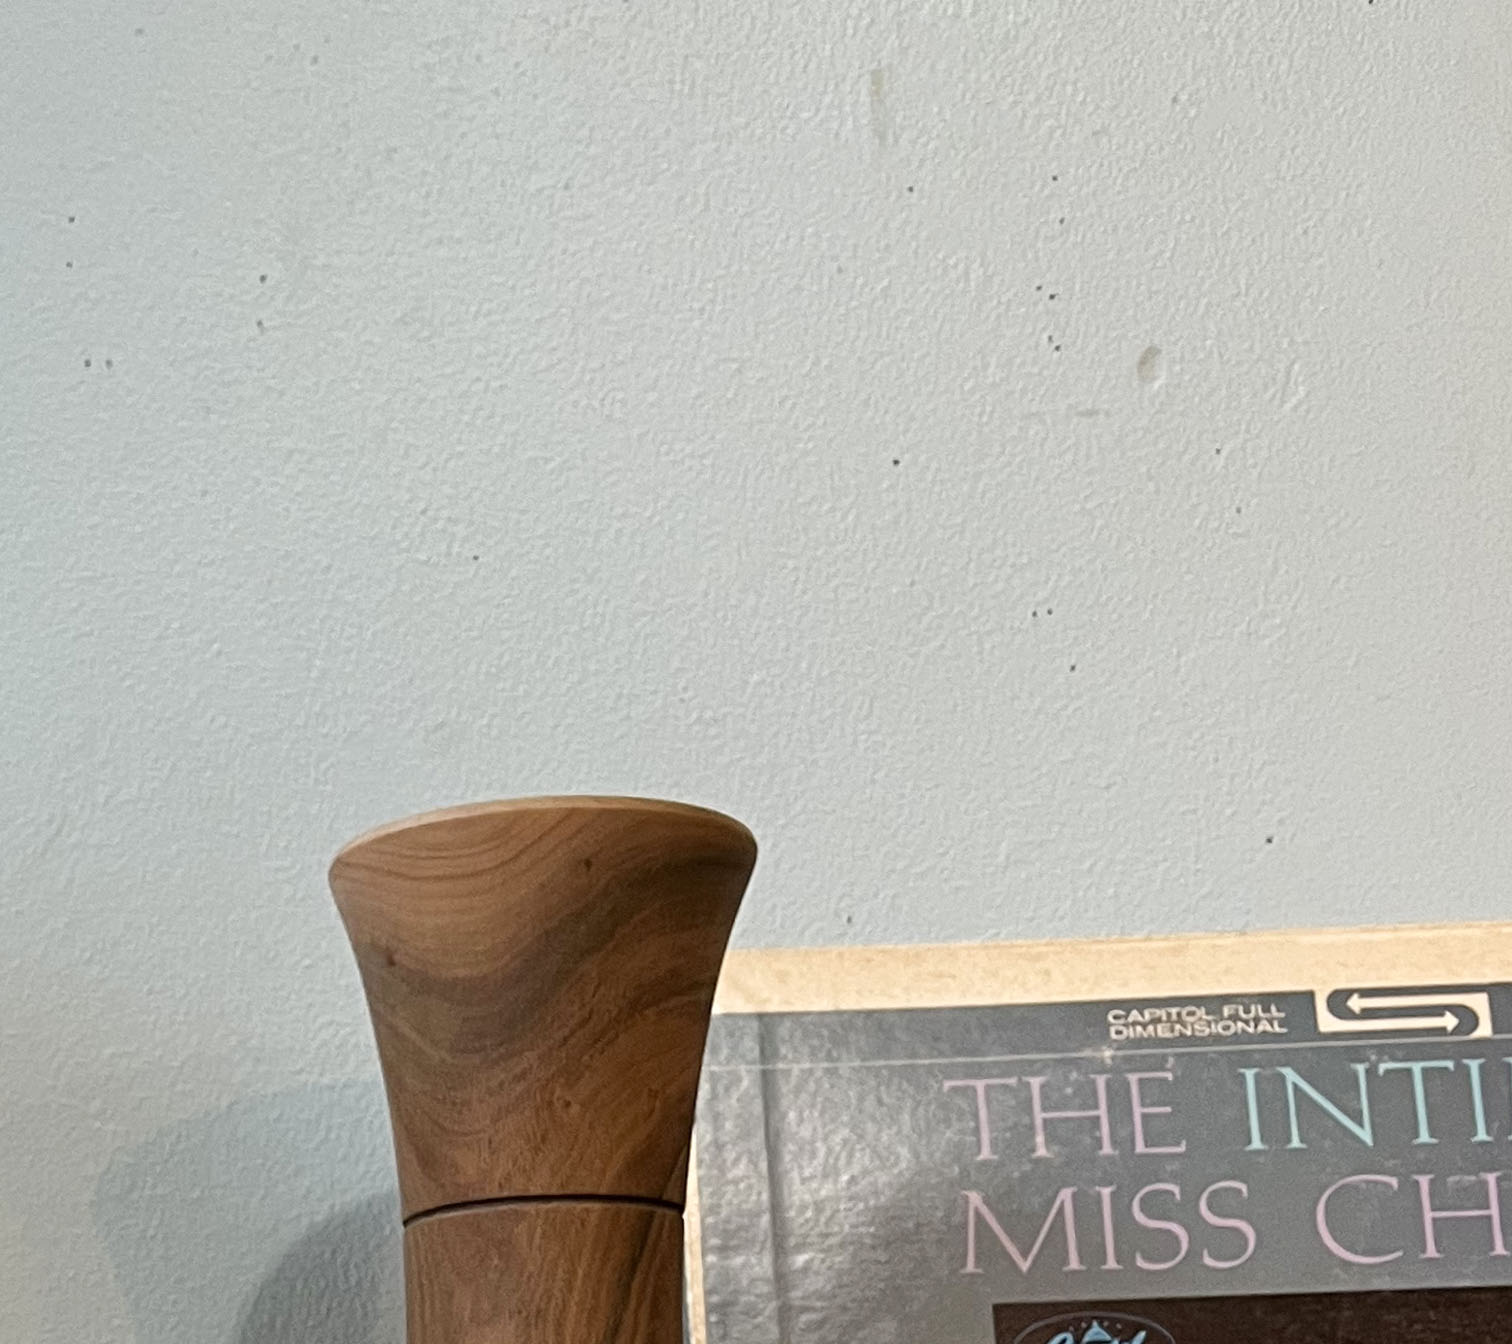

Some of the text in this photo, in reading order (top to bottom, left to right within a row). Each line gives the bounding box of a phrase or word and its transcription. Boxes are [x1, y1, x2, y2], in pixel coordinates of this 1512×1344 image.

[1107, 1003, 1287, 1025] CAPITOL FULL
[1108, 1018, 1288, 1040] DIMENSIONAL
[942, 1056, 1512, 1160] THE INTI
[959, 1171, 1511, 1275] MISS CH
